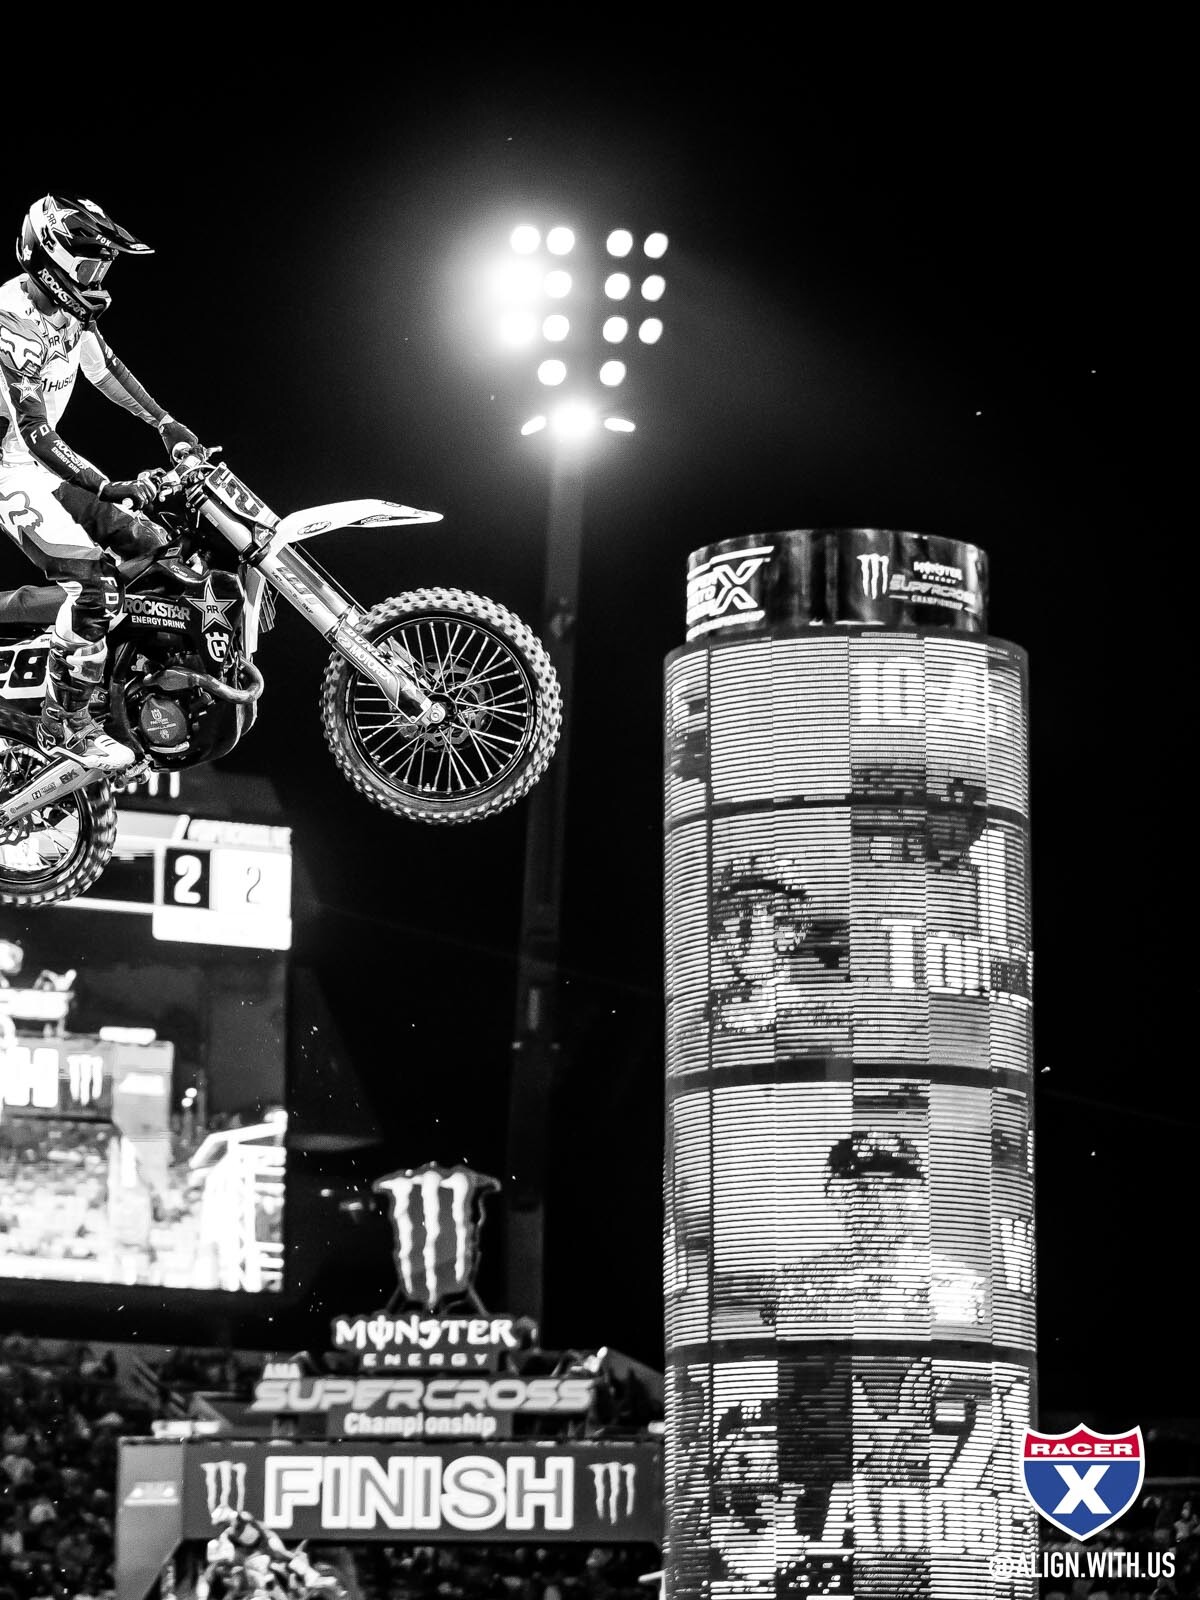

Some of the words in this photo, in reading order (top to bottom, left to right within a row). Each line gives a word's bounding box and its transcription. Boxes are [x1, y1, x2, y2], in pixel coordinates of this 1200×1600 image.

[95, 235, 112, 247] FOX
[100, 576, 119, 619] FOX
[124, 598, 191, 621] ROCKSTAR
[131, 615, 162, 626] ENERGY
[163, 618, 186, 630] DRINK
[173, 854, 202, 905] 2
[335, 1314, 519, 1351] MONSTER
[362, 1352, 489, 1367] ENERGY
[250, 1378, 595, 1412] SUPERCROSS
[343, 1412, 497, 1437] Championship
[264, 1456, 575, 1530] FINISH
